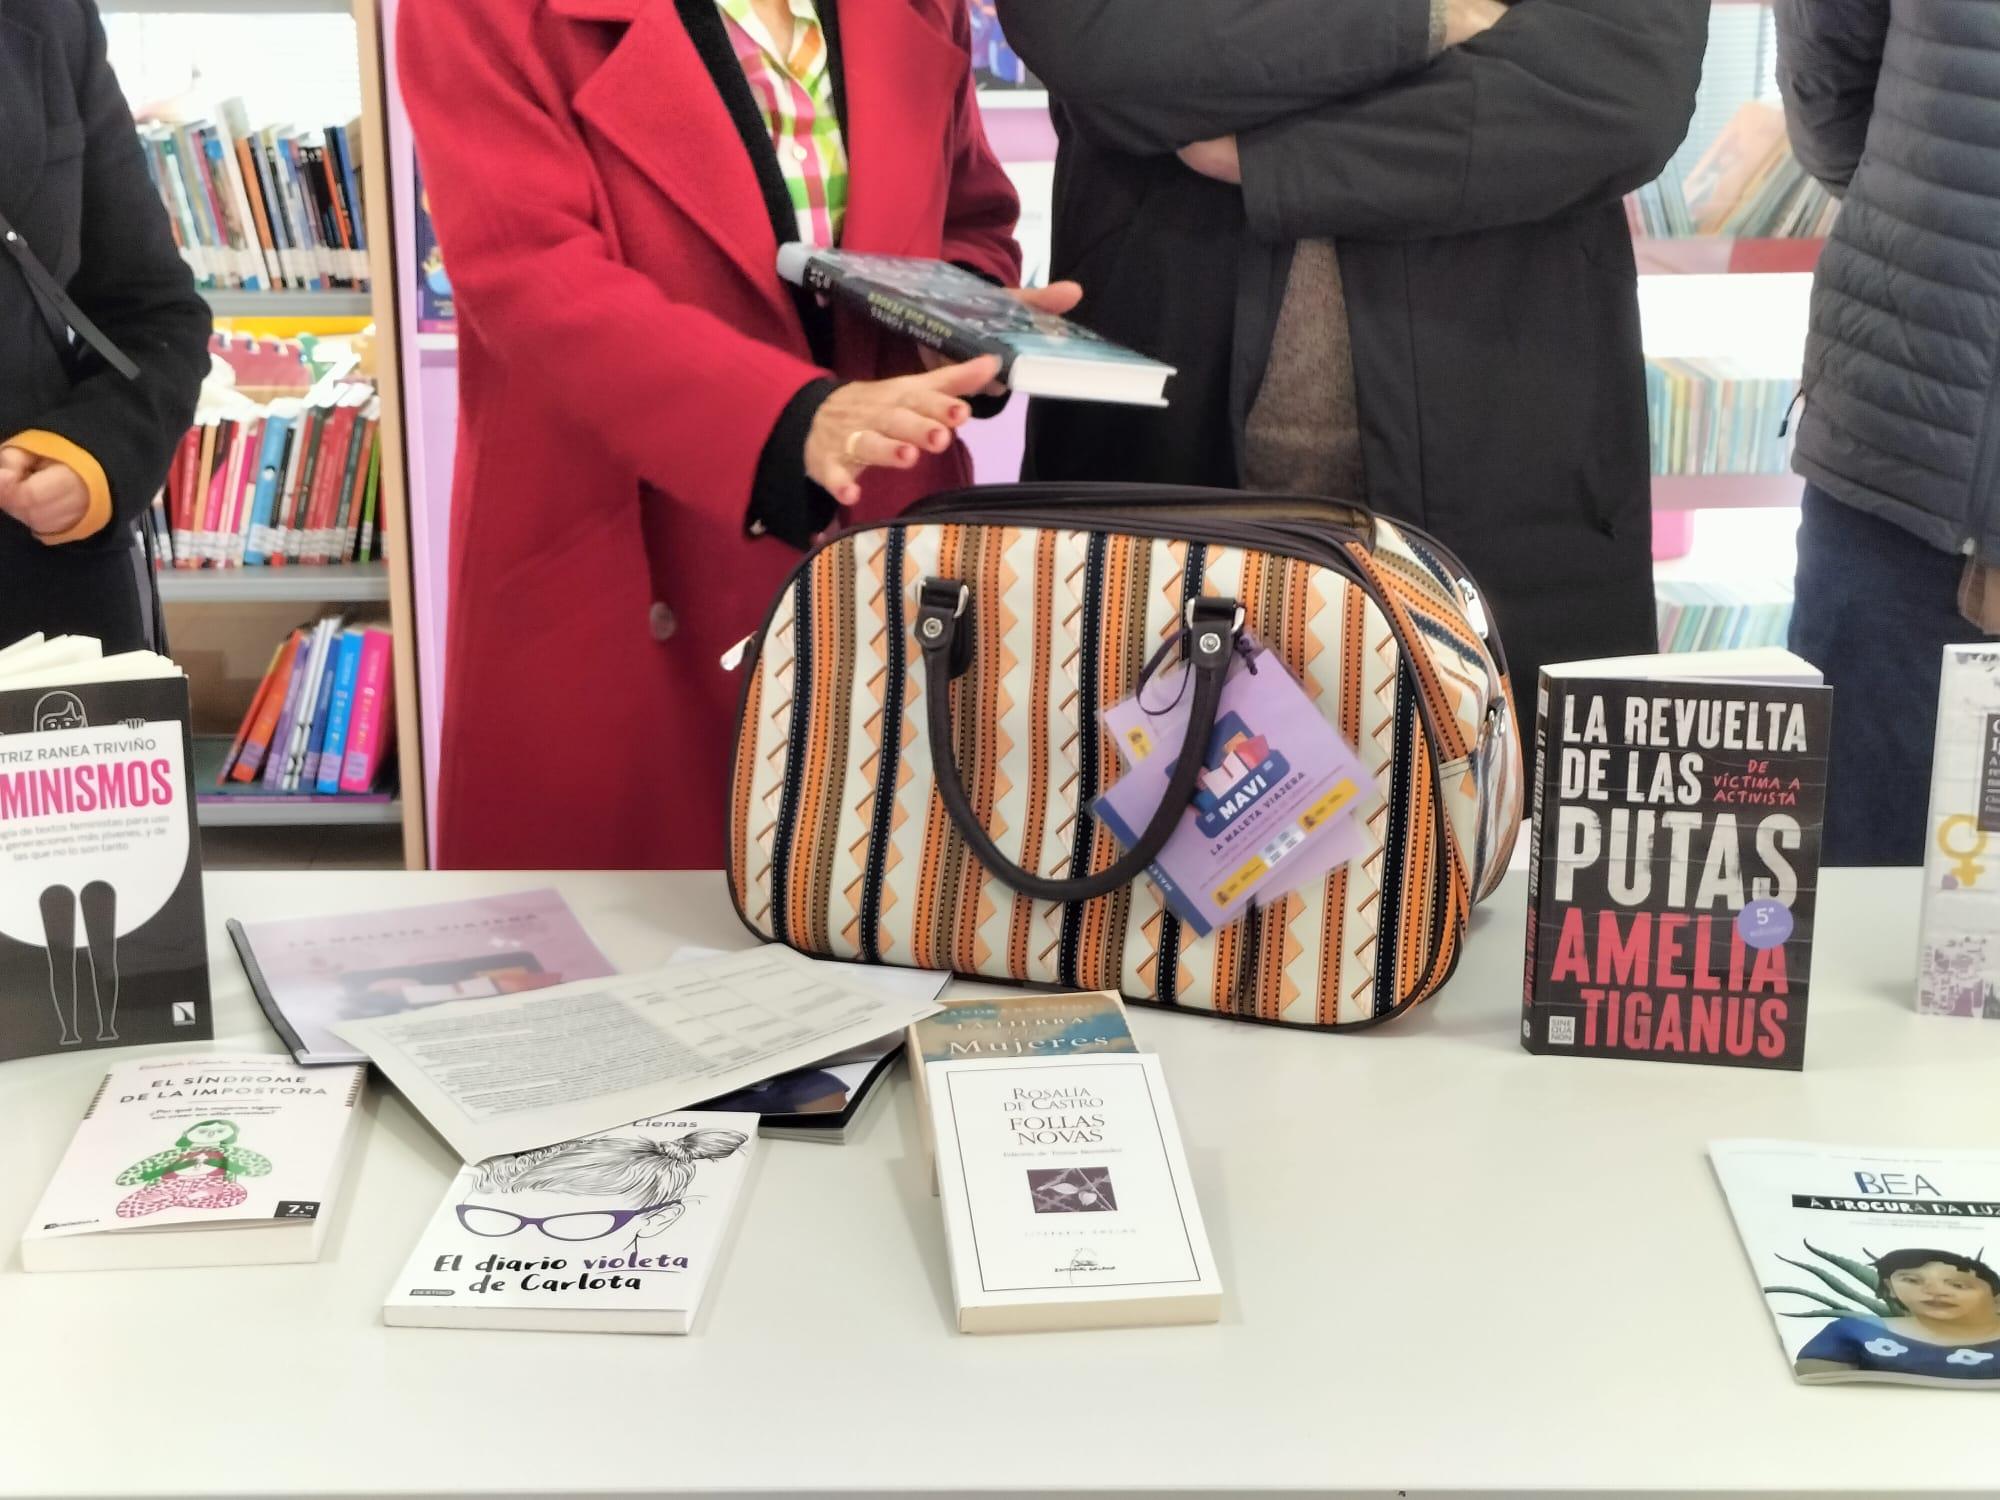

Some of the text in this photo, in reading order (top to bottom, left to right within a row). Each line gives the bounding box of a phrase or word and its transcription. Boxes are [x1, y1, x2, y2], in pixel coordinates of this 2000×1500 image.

[1563, 694, 1608, 743] LA
[1624, 696, 1807, 753] REVUELTA
[1537, 728, 1546, 747] LA
[0, 738, 156, 764] TRIZ RANEA TRIVIÑO
[1560, 748, 1704, 805] DE LAS
[1747, 760, 1769, 774] DE
[0, 759, 172, 820] MINISMOS
[1713, 772, 1801, 791] VÍCTIMA A
[1219, 774, 1268, 821] MAVI
[1713, 789, 1796, 806] ACTIVISTA
[1210, 842, 1224, 856] LA
[1225, 809, 1263, 843] MALETA
[1263, 771, 1306, 808] VIAJERA
[1555, 805, 1801, 912] PUTAS
[1551, 907, 1789, 994] AMELIA
[1581, 989, 1789, 1059] TIGANUS
[950, 1035, 1109, 1055] Mujeres
[151, 1074, 307, 1088] EL SÍNDROME
[119, 1087, 328, 1103] DE LA IMPOSTORA
[1003, 1098, 1104, 1111] DE CASTRO
[1009, 1114, 1105, 1131] FOLLAS
[1017, 1129, 1103, 1145] NOVAS
[1854, 1171, 1943, 1197] BEA
[1830, 1199, 1927, 1213] PROCURA
[1932, 1203, 1963, 1215] DA
[1967, 1203, 2000, 1217] LUZ
[434, 1251, 688, 1273] El diario violeta
[468, 1272, 642, 1294] de Carlota
